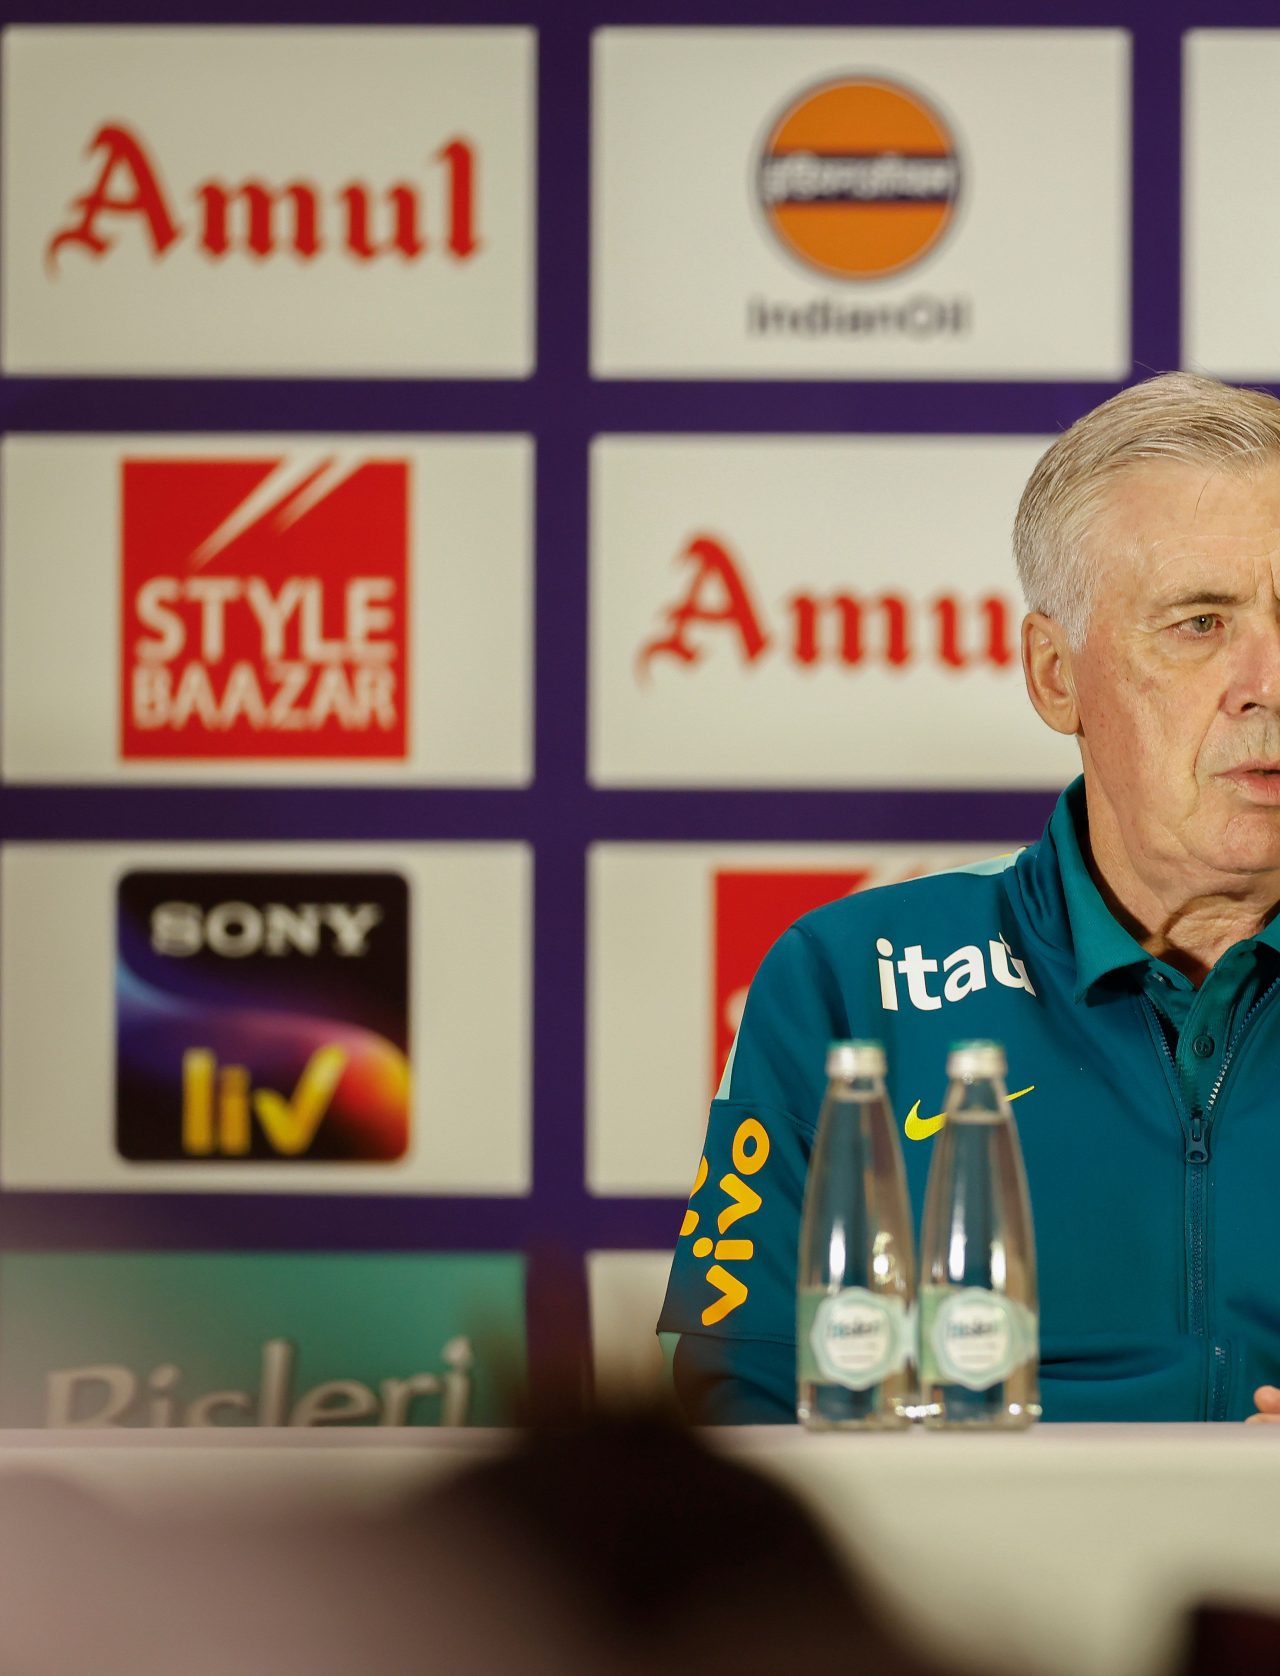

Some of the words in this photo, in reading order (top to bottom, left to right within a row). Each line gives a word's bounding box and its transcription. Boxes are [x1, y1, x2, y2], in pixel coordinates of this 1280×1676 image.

[44, 120, 482, 276] Amul
[134, 576, 396, 662] STYLE
[637, 524, 1019, 684] Amu
[131, 659, 397, 731] BAAZAR
[151, 901, 379, 957] SONY
[692, 1118, 770, 1326] vivo
